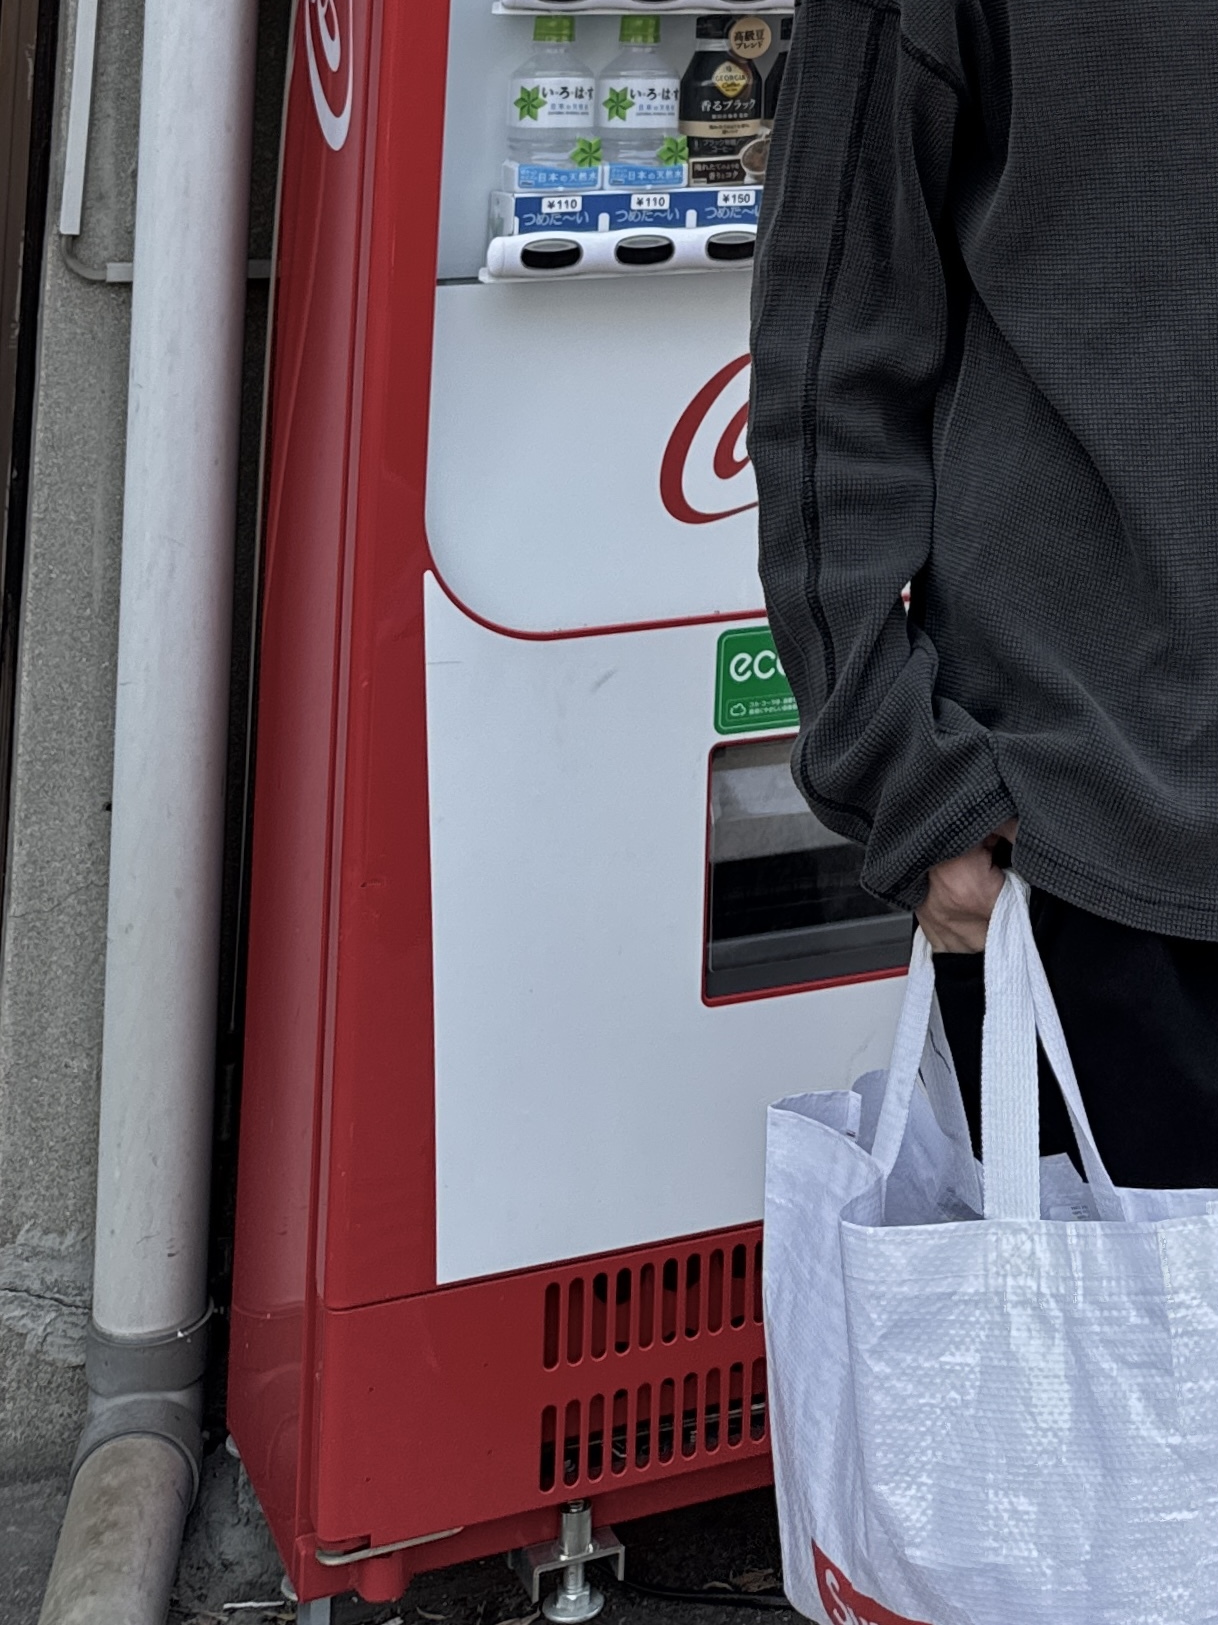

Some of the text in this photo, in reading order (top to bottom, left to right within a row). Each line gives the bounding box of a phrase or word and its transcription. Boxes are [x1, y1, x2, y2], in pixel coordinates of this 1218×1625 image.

[701, 98, 756, 112] 香るブラック
[547, 198, 578, 211] ¥110
[636, 195, 666, 208] ¥110
[722, 193, 751, 205] ¥150
